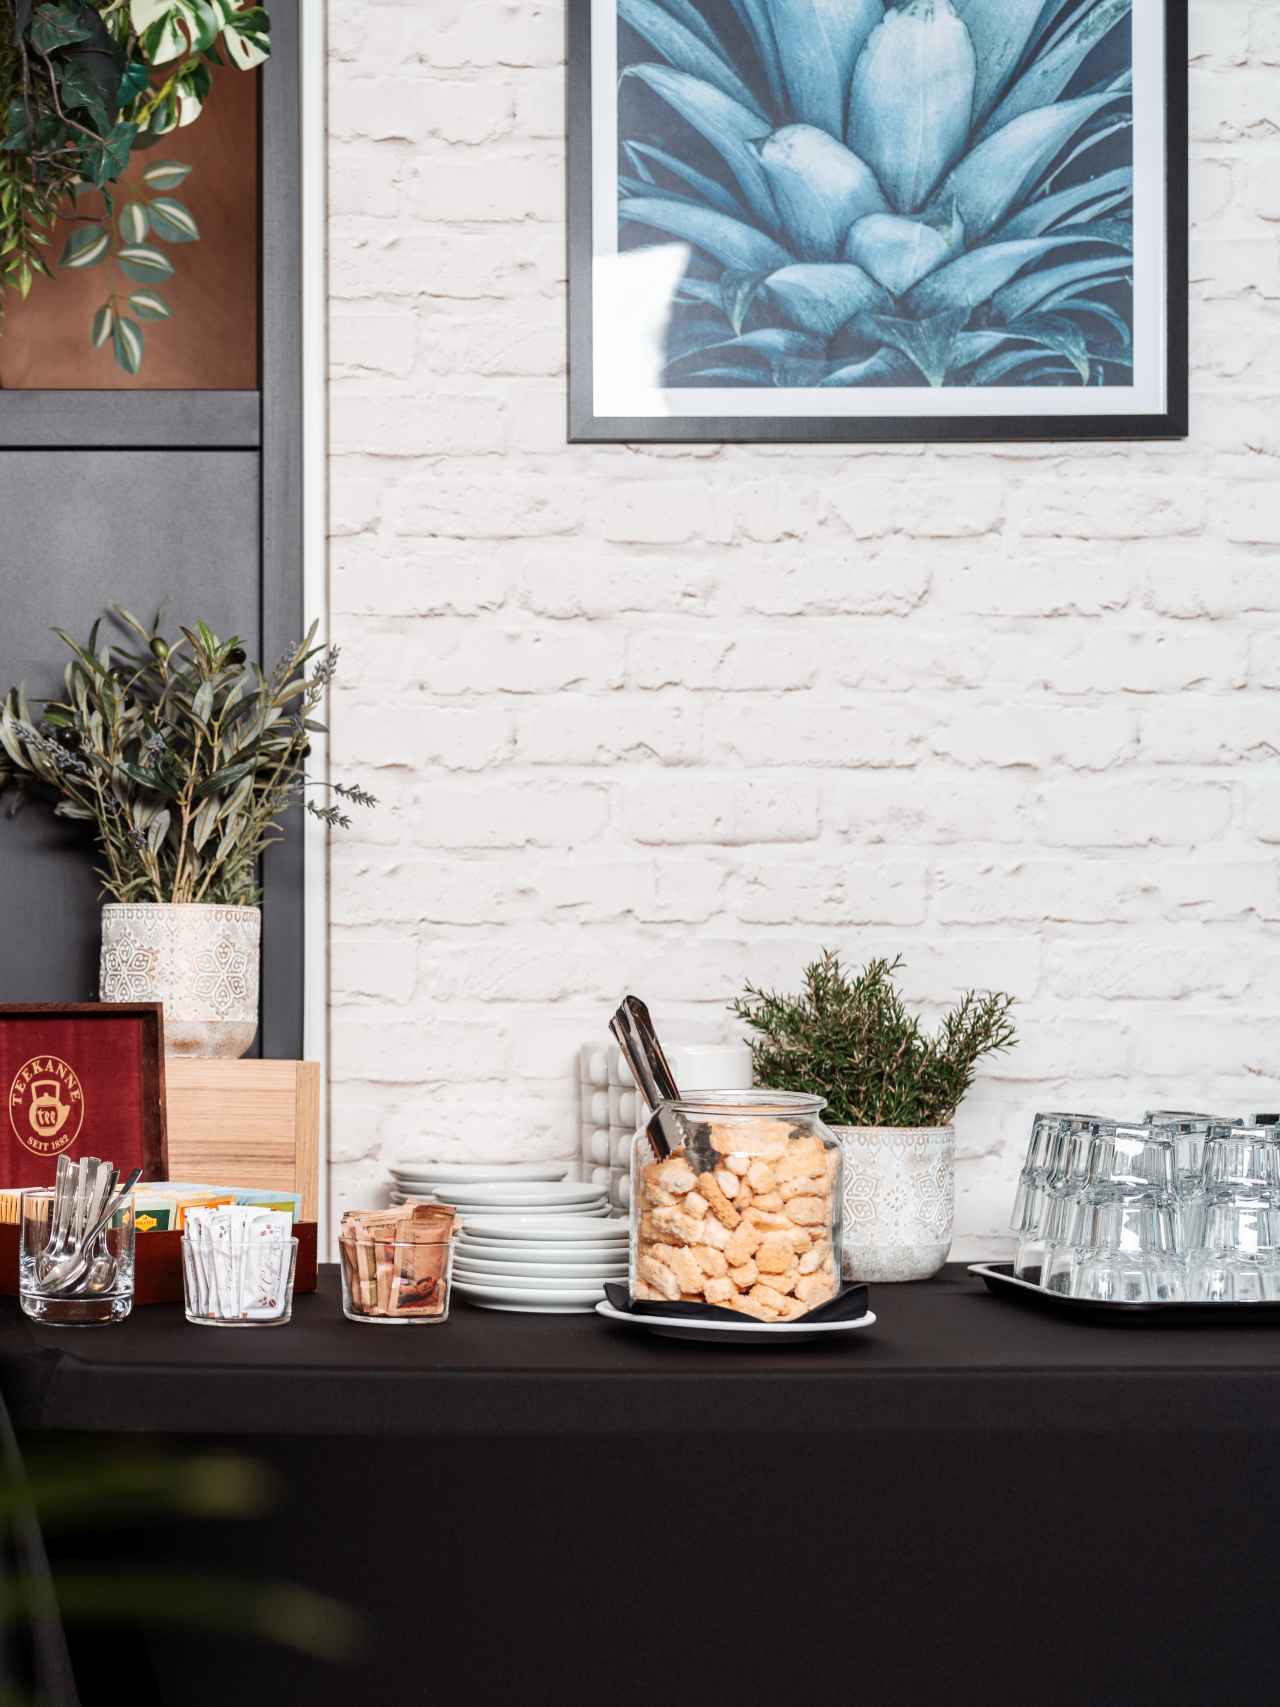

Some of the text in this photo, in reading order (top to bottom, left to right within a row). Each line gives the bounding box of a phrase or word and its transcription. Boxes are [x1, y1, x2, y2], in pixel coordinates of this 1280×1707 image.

[12, 1059, 81, 1106] TEEKANNE
[26, 1134, 70, 1152] SEIT 1882
